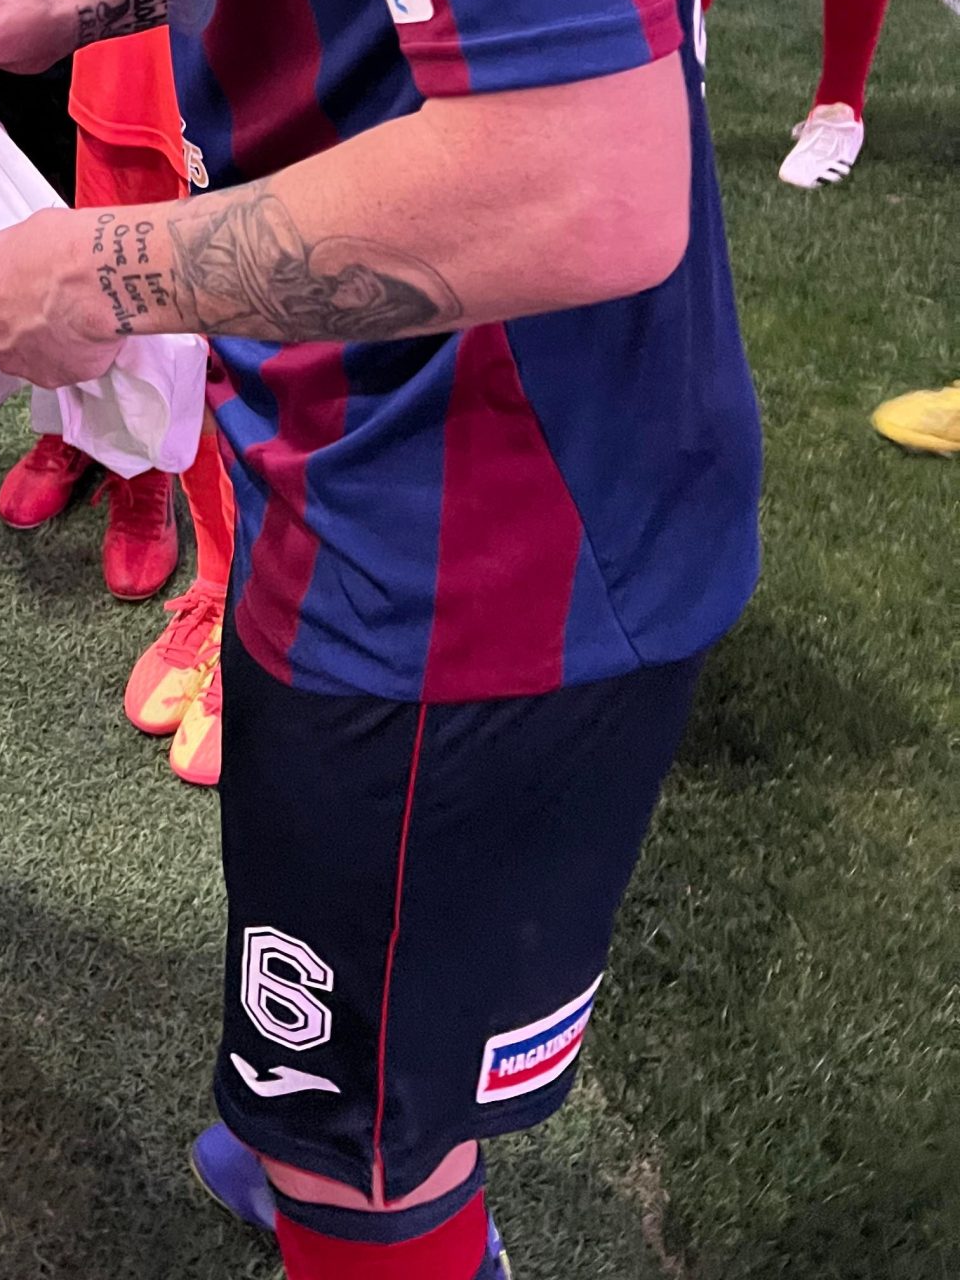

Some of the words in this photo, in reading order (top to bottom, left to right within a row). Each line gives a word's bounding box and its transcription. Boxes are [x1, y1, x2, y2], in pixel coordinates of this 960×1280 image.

[92, 213, 116, 255] One
[113, 224, 130, 267] One
[135, 221, 154, 265] One
[145, 272, 170, 307] life
[240, 926, 334, 1051] 6
